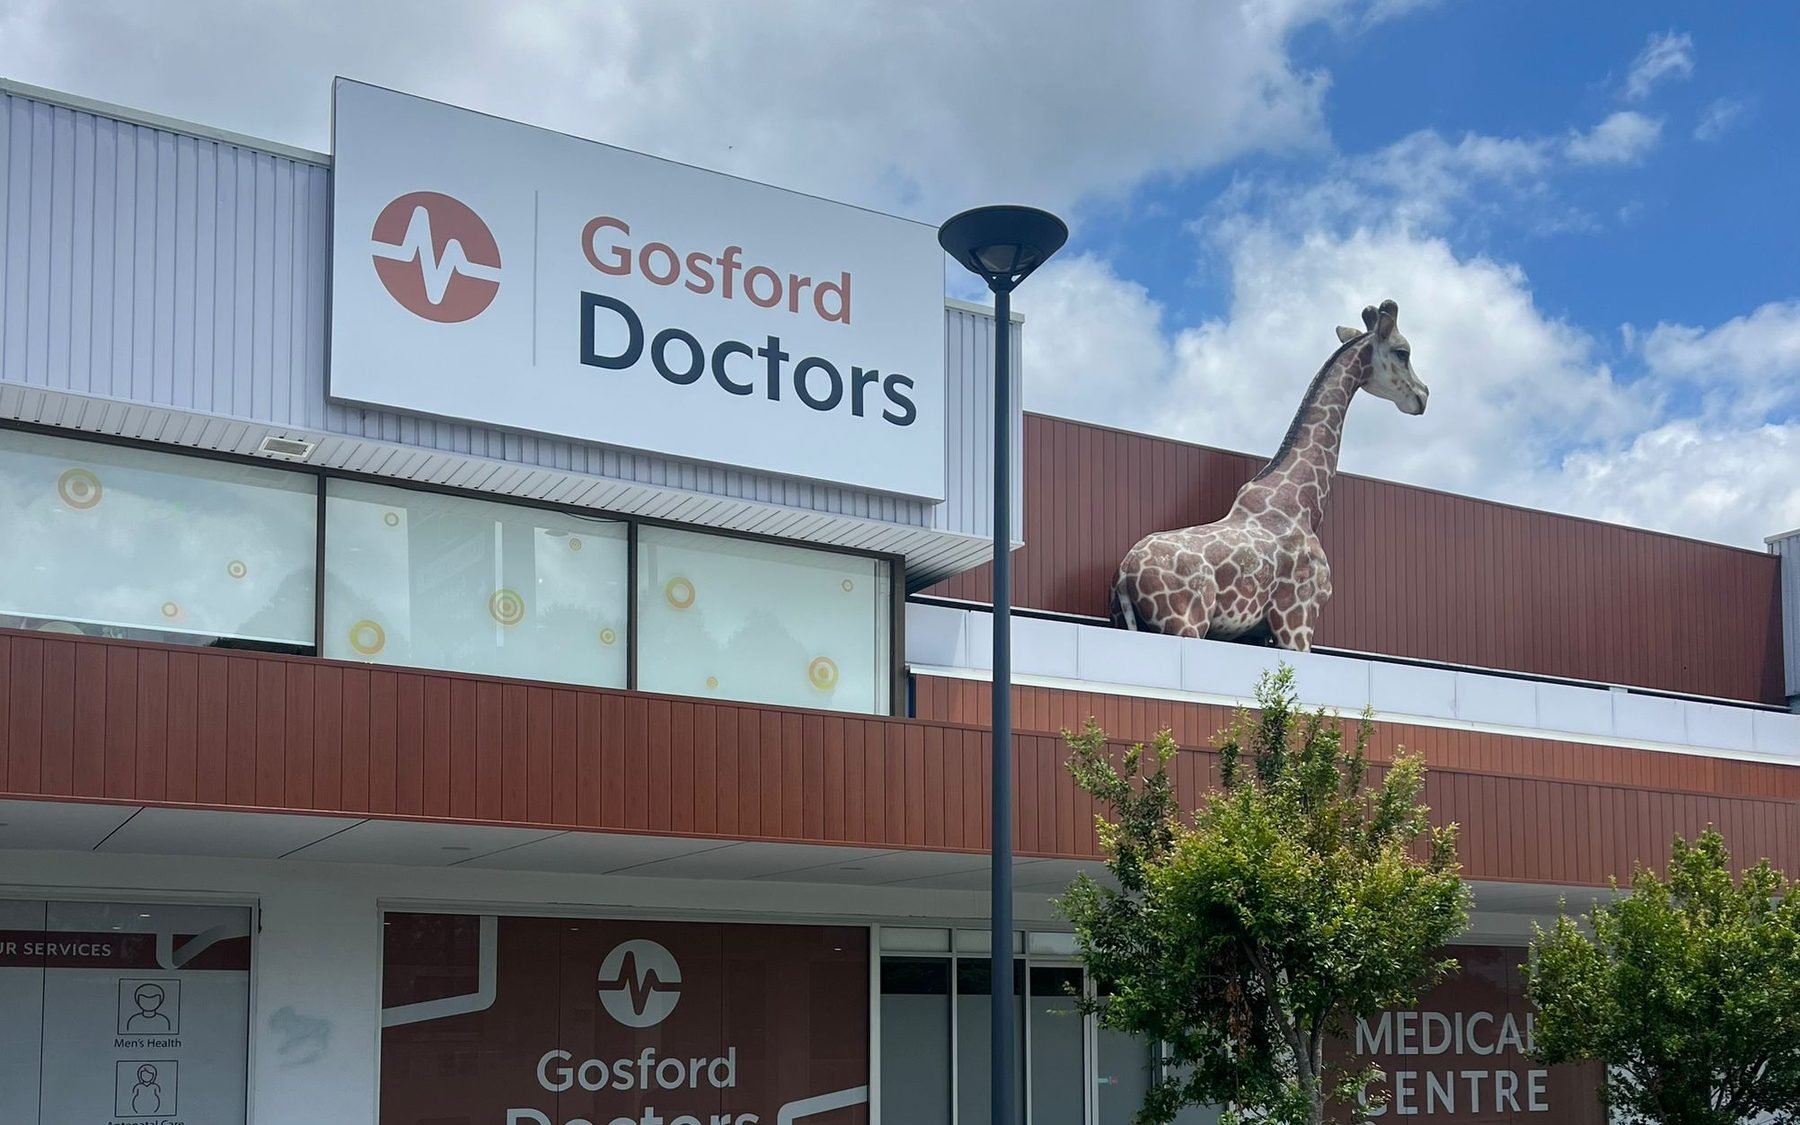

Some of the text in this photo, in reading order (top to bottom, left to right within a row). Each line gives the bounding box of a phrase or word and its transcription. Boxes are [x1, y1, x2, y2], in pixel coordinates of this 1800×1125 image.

[581, 215, 851, 325] Gosford
[580, 290, 917, 427] Doctors
[23, 942, 112, 957] SERVICES
[147, 1038, 182, 1048] Health
[537, 1047, 736, 1092] Gosford
[1357, 1068, 1549, 1117] CENTRE
